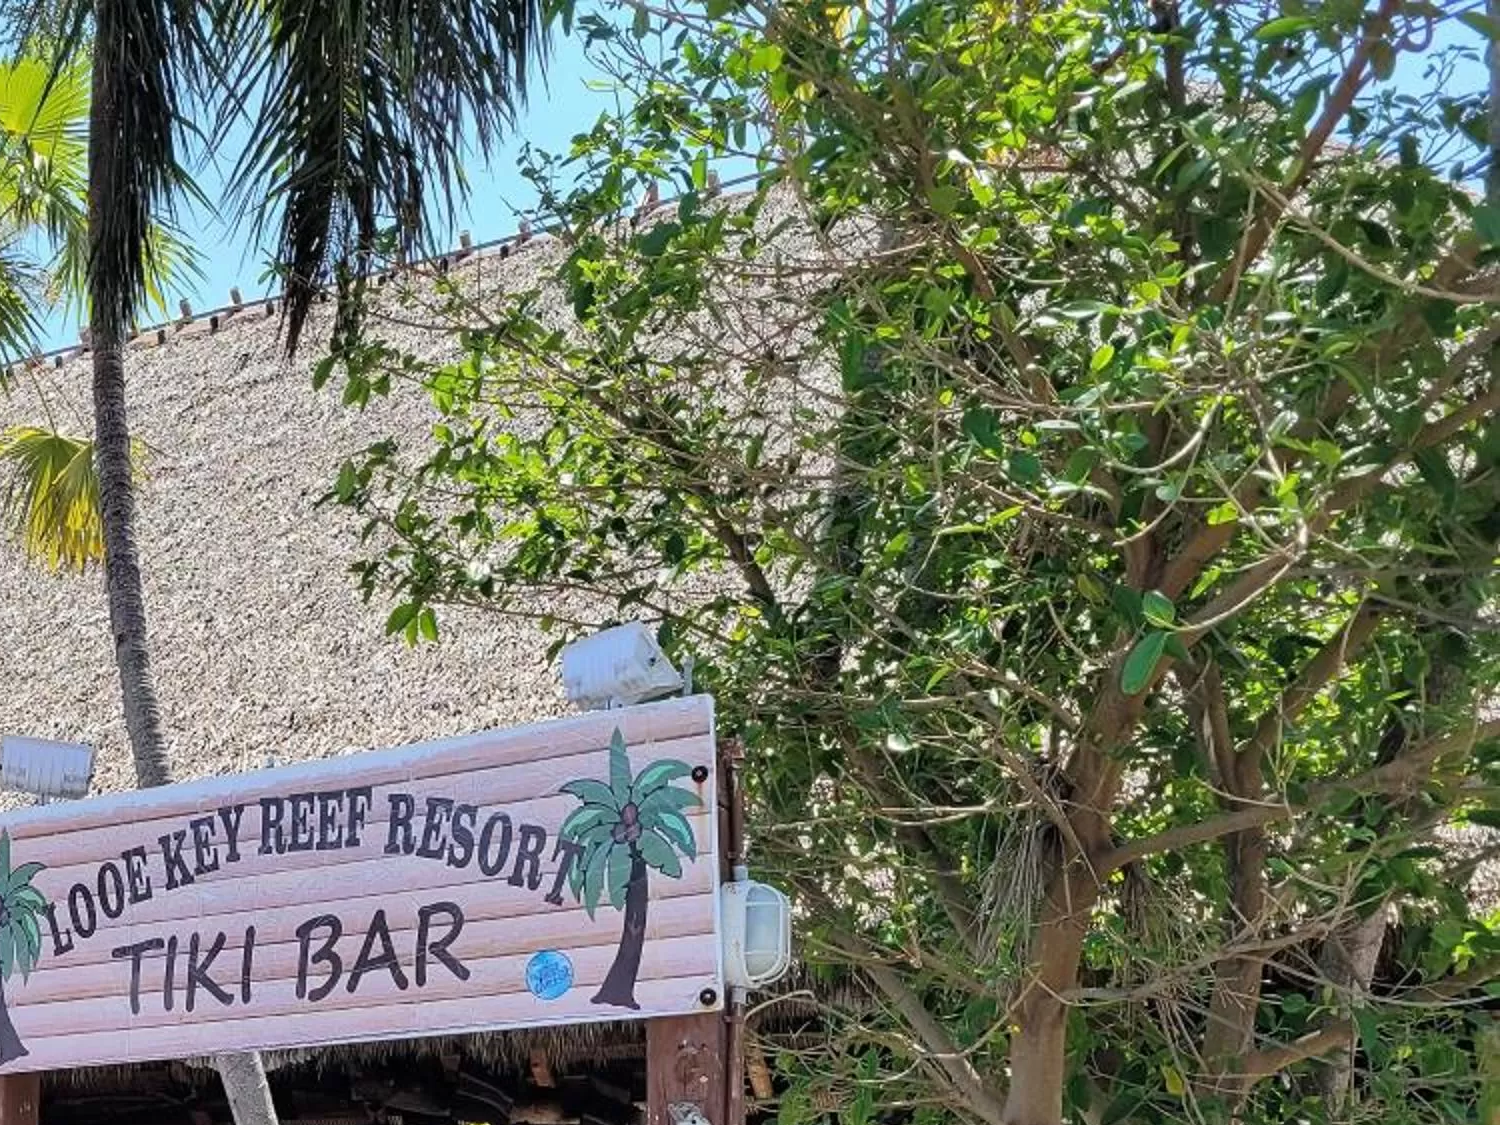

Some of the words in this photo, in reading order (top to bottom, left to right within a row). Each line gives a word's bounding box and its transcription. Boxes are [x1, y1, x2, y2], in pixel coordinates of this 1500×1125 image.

[49, 845, 153, 957] LOOE
[158, 803, 245, 891] KEY
[257, 786, 373, 855] REEF
[384, 792, 585, 906] RESORT
[111, 925, 256, 1015] TIKI
[295, 901, 471, 1002] BAR
